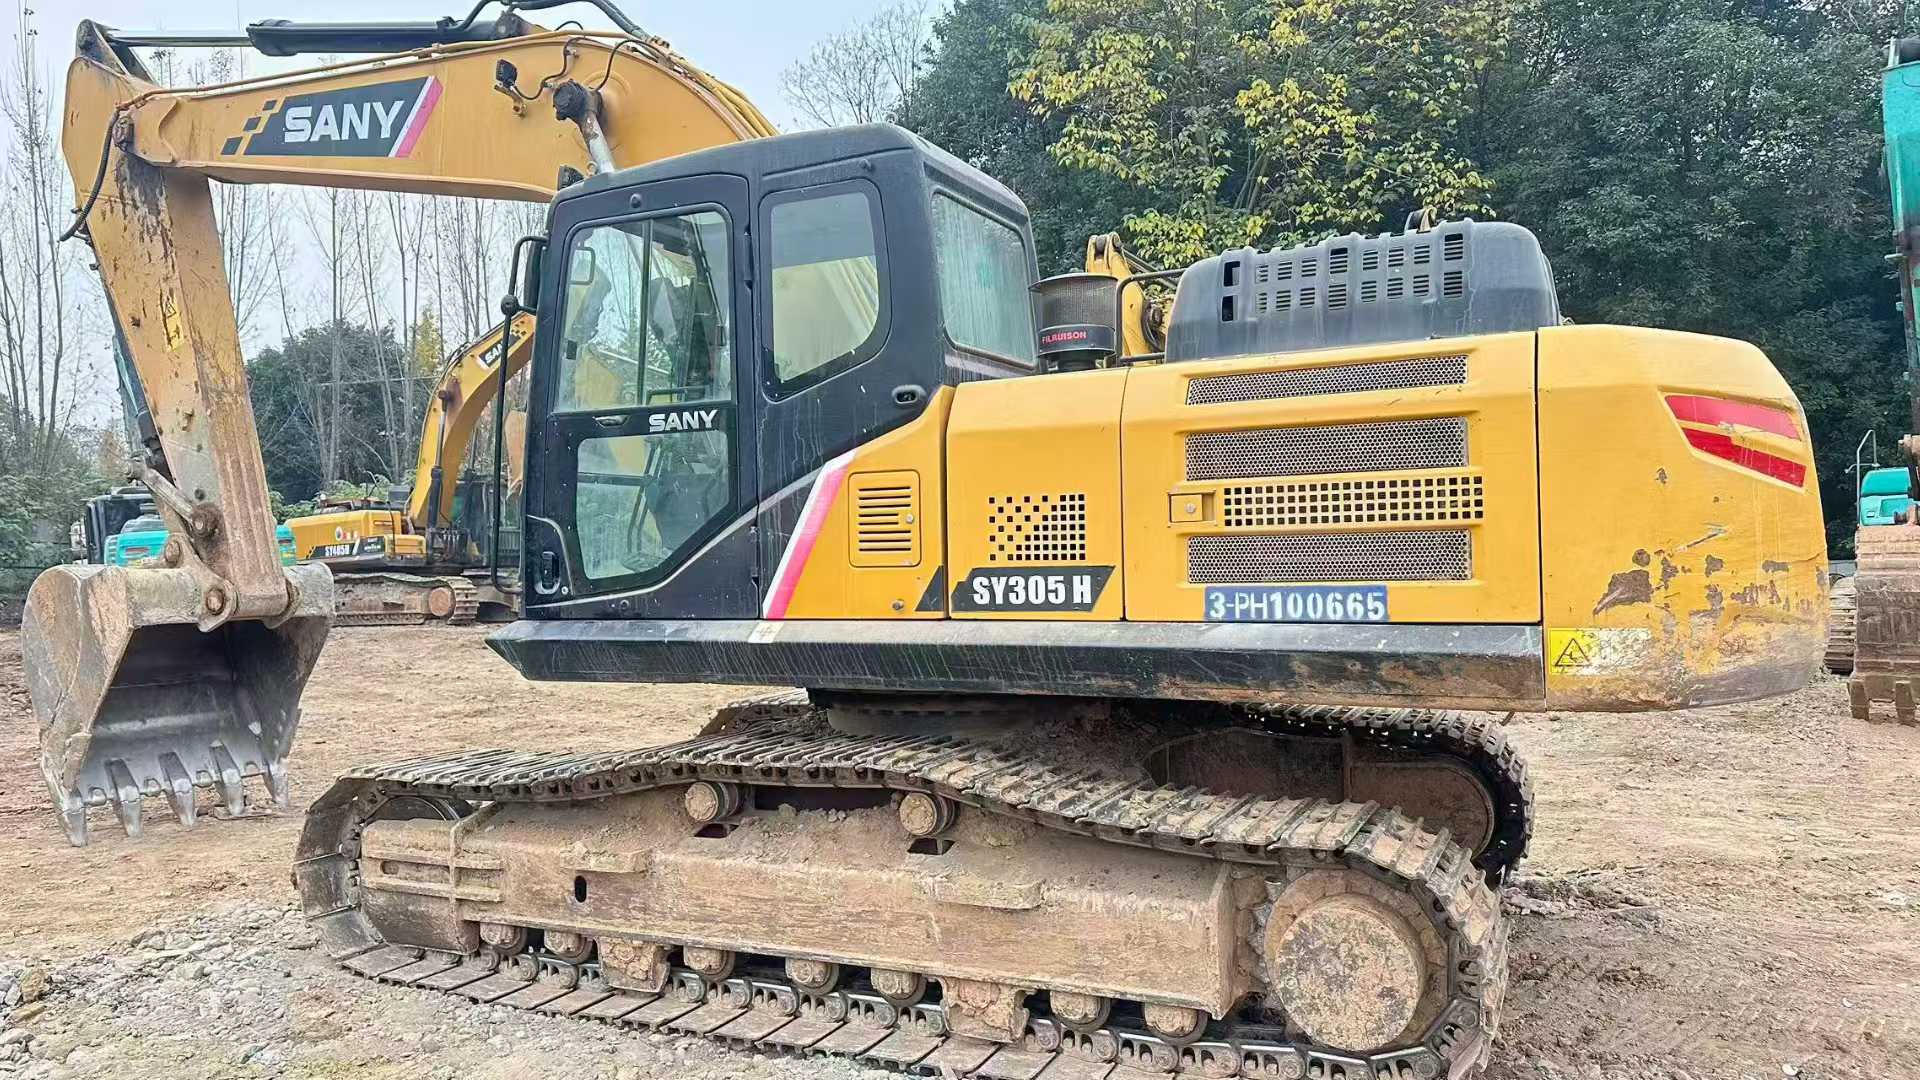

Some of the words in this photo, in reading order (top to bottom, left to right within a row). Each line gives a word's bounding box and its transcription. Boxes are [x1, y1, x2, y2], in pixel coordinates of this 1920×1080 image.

[283, 100, 404, 143] SANY
[648, 409, 718, 432] SANY
[972, 575, 1067, 605] SY305
[1072, 575, 1092, 604] H
[1208, 592, 1386, 620] 3-PH100665
